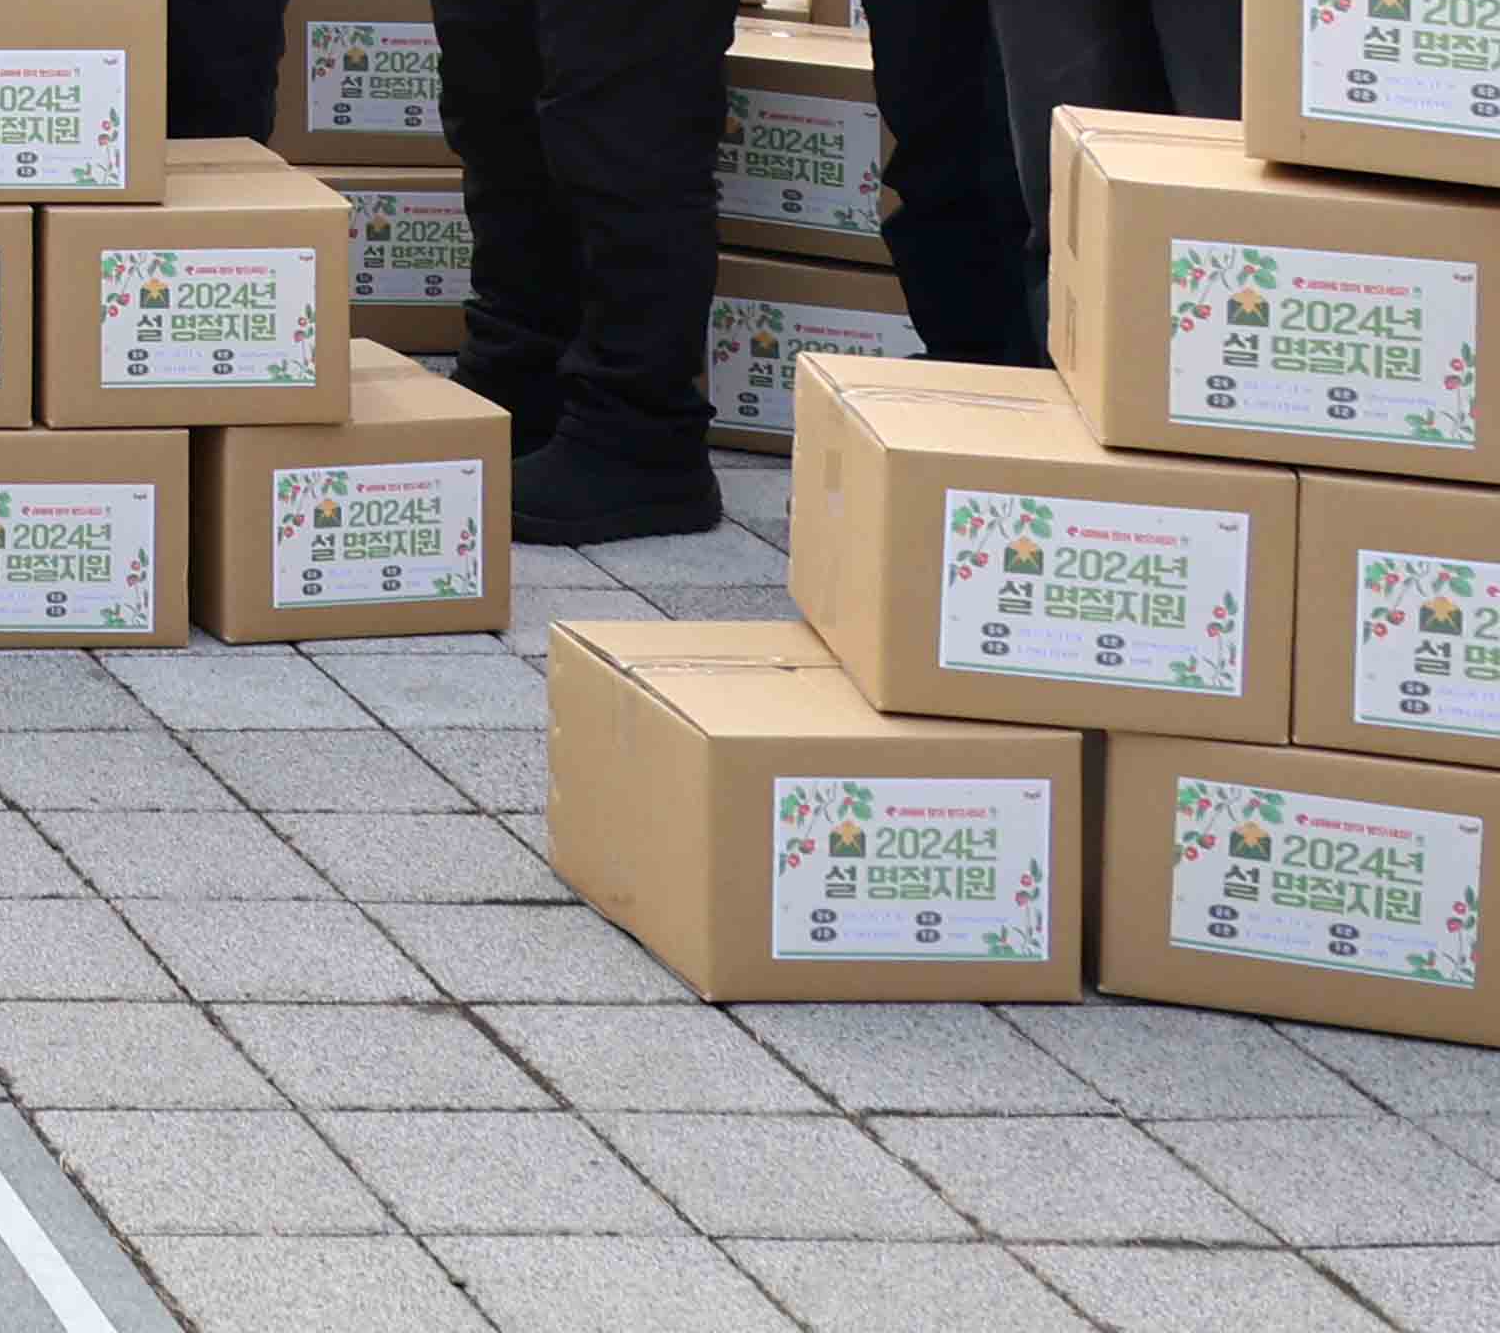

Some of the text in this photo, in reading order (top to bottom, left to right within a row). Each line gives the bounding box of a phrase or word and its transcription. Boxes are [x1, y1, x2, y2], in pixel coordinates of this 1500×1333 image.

[1363, 25, 1400, 62] 설
[178, 281, 277, 310] 2024년
[137, 312, 278, 342] 설 명절지원
[1281, 297, 1422, 342] 2024년
[1223, 332, 1423, 383] 설 명절지원
[13, 522, 112, 551] 2024년
[6, 554, 112, 583] 명절지원
[1054, 546, 1188, 590] 2024년
[998, 580, 1187, 630] 설 명절지원
[1414, 639, 1452, 677] 설
[876, 827, 997, 861] 2024년
[1283, 833, 1425, 886] 2024년
[825, 866, 997, 901] 설 명절지원
[1225, 864, 1424, 925] 설 명절지원
